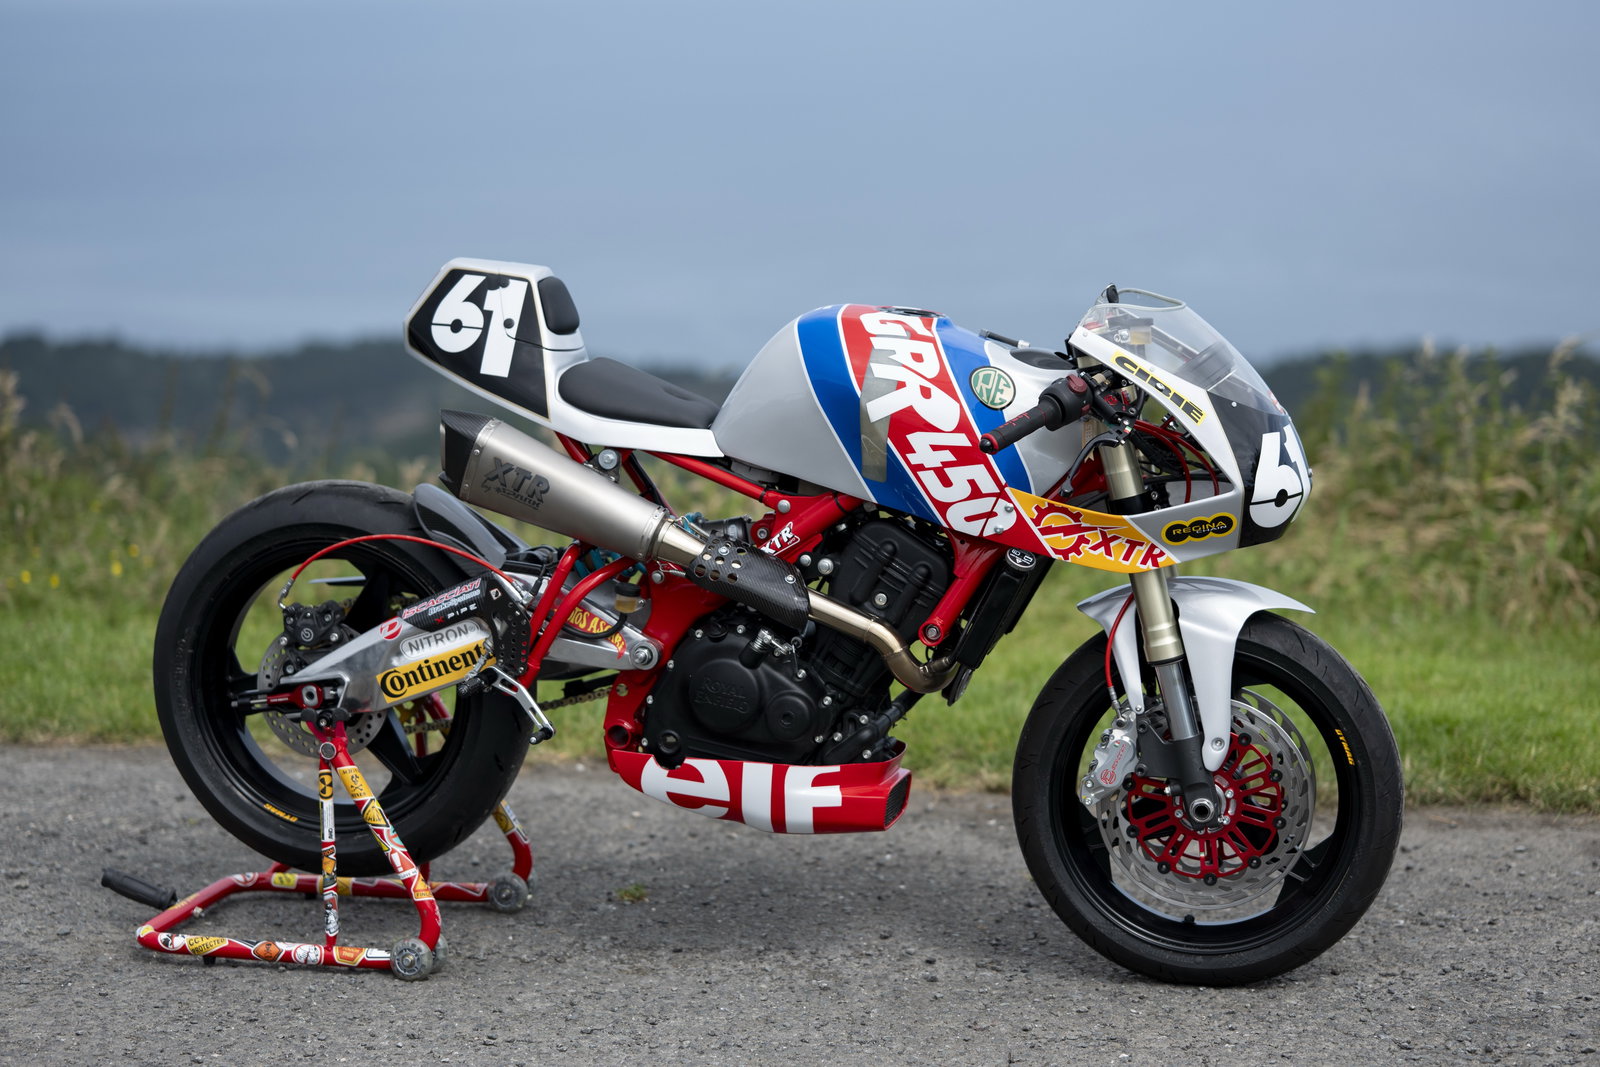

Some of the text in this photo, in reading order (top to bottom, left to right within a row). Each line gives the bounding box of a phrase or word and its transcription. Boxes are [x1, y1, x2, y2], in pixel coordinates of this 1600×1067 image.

[431, 274, 528, 378] 61
[484, 457, 551, 504] XTR
[905, 431, 1018, 537] 450
[760, 526, 795, 554] XTR
[1172, 521, 1227, 535] REGINA
[1196, 525, 1227, 534] CHAIN
[1088, 532, 1167, 570] XTR
[641, 757, 843, 834] elf
